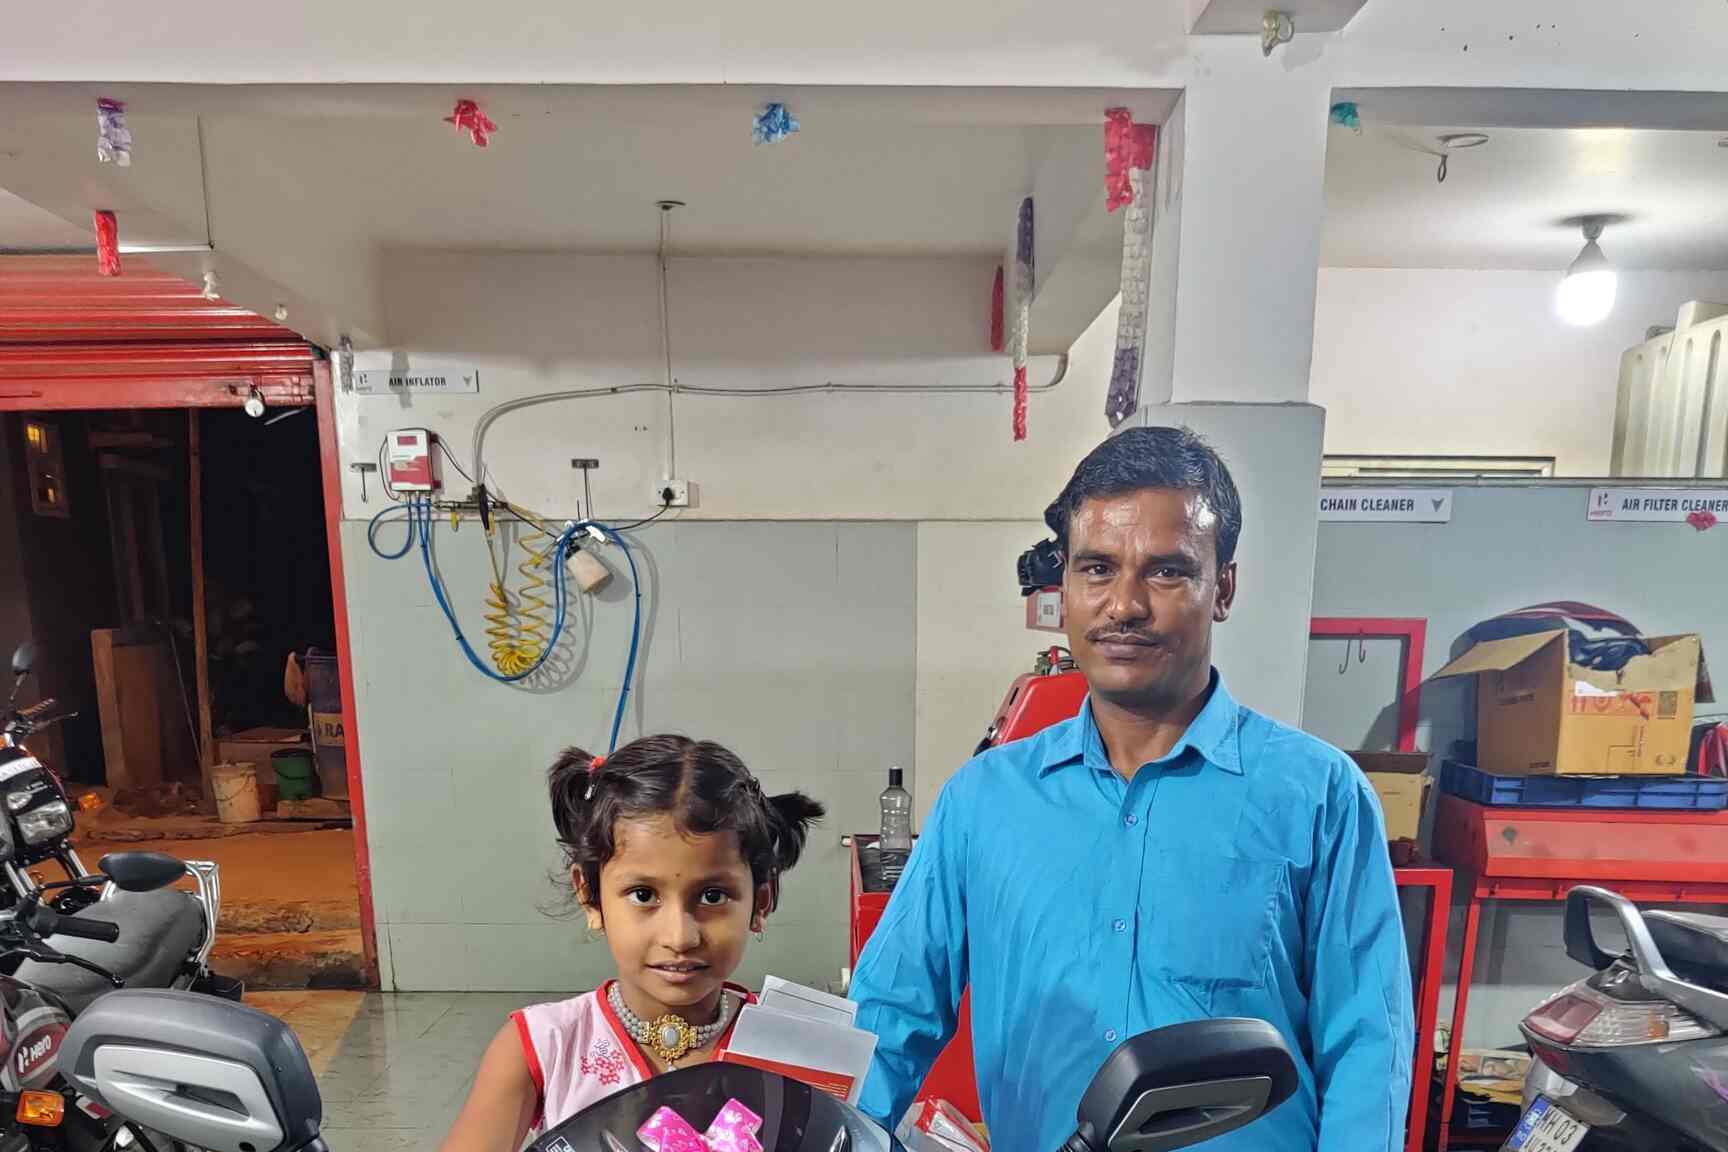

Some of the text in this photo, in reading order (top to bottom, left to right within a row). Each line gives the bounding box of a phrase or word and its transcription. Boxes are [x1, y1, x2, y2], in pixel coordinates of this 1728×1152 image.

[389, 376, 447, 386] AIR INFLATOR
[1320, 498, 1414, 511] CHAIN CLEANER
[1622, 498, 1728, 512] AIR FILTER CLEANER
